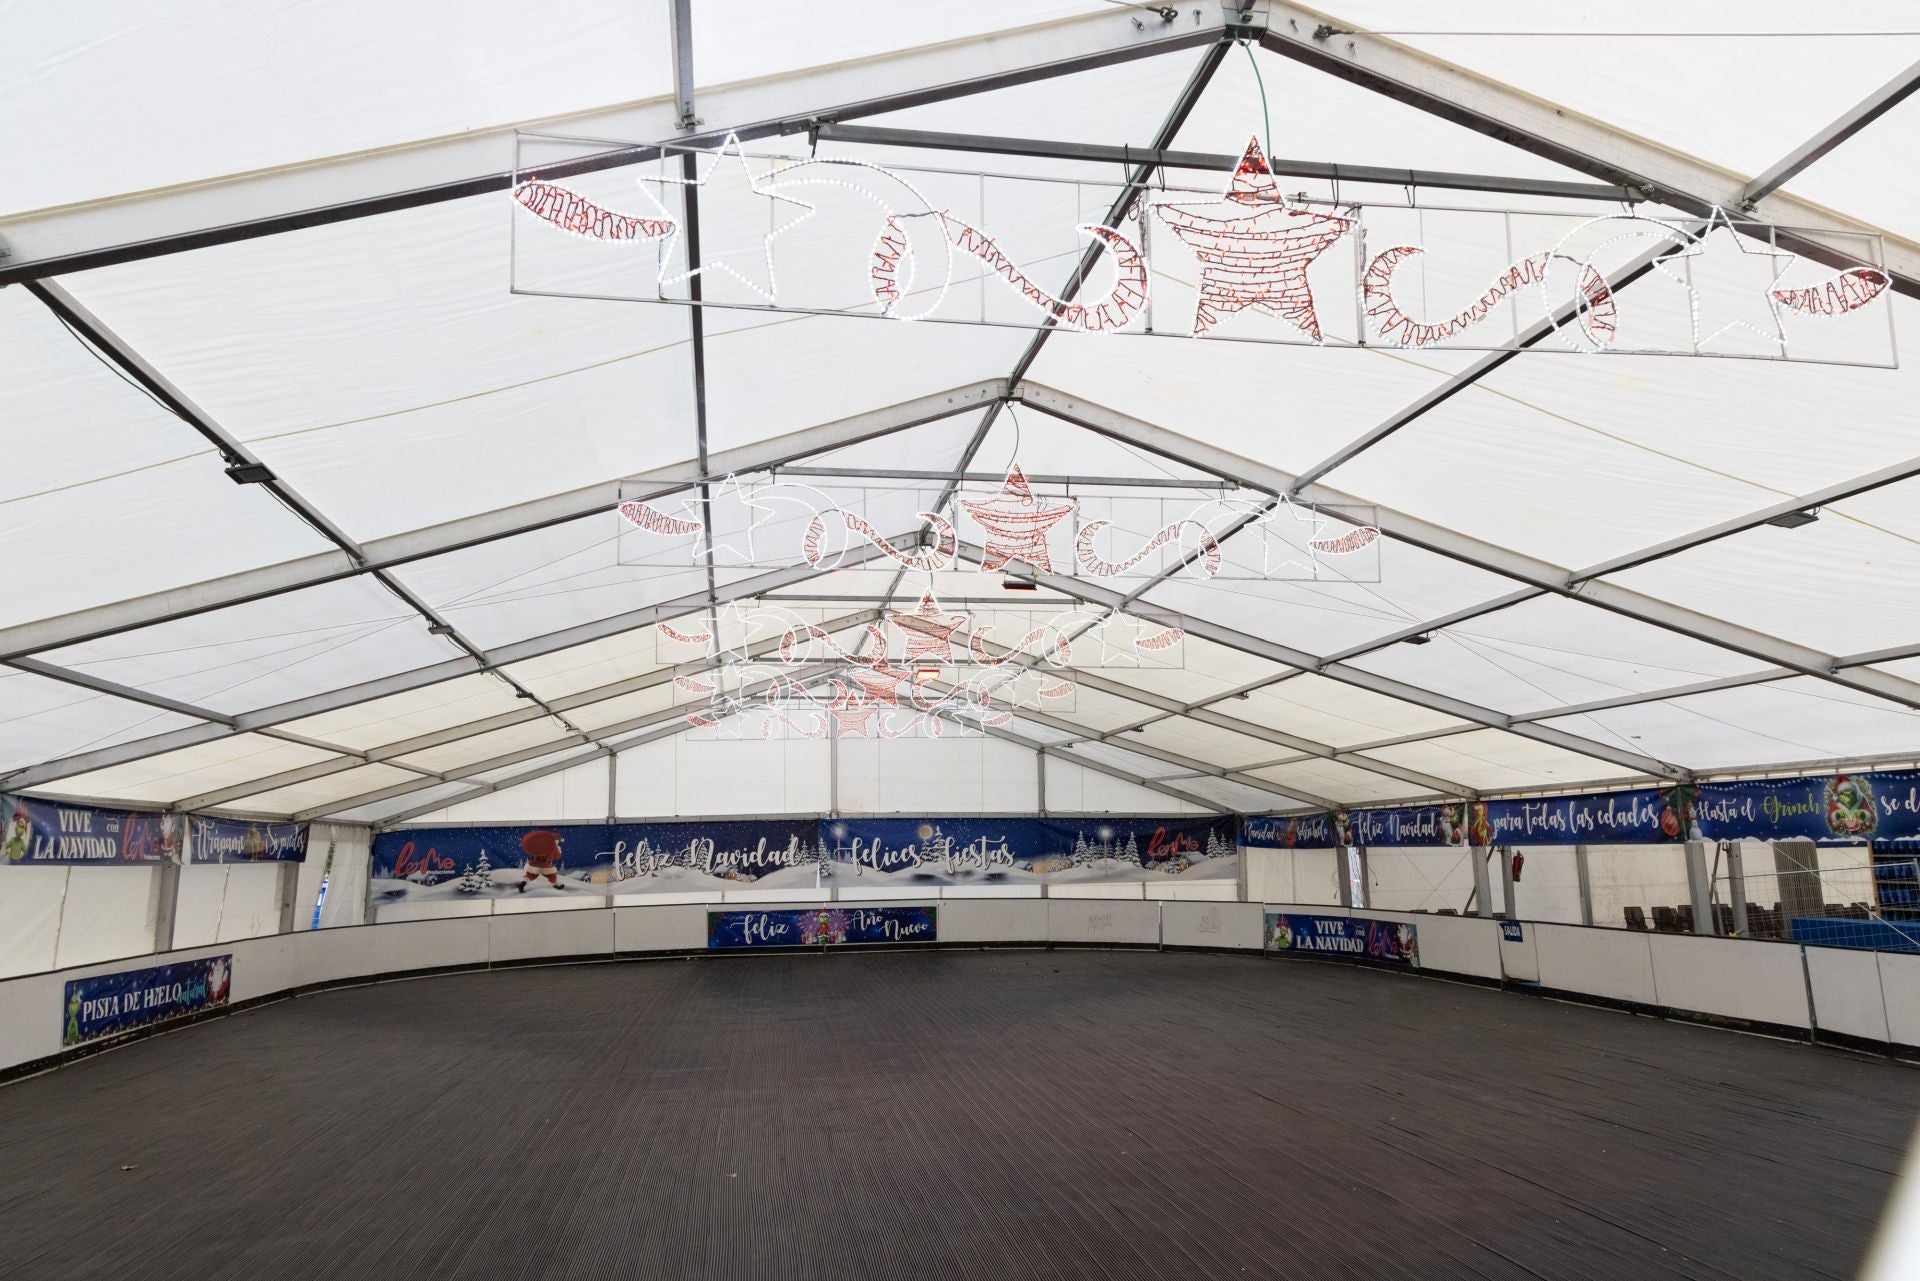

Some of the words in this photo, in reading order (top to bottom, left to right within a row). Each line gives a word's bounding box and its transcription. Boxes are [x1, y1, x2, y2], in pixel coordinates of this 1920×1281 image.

[1492, 812, 1523, 840] para
[1521, 802, 1566, 835] todas
[1569, 800, 1594, 834] las
[1598, 797, 1659, 829] edades
[1693, 798, 1737, 823] Hasta
[1741, 798, 1756, 822] el
[1760, 793, 1821, 824] Grinch
[58, 809, 92, 832] VIVE
[107, 823, 120, 833] con
[1244, 818, 1275, 842] Navidad
[1389, 812, 1438, 840] Navidad
[33, 836, 54, 859] LA
[57, 837, 116, 859] NAVIDAD
[681, 836, 803, 874] Navidad
[851, 910, 883, 931] Año
[879, 919, 928, 940] Nuevo
[1315, 920, 1344, 935] VIVE
[1296, 936, 1314, 949] LA
[1316, 936, 1364, 953] NAVIDAD
[83, 994, 119, 1022] PISTA
[124, 992, 141, 1013] DE
[144, 982, 182, 1008] HIELO
